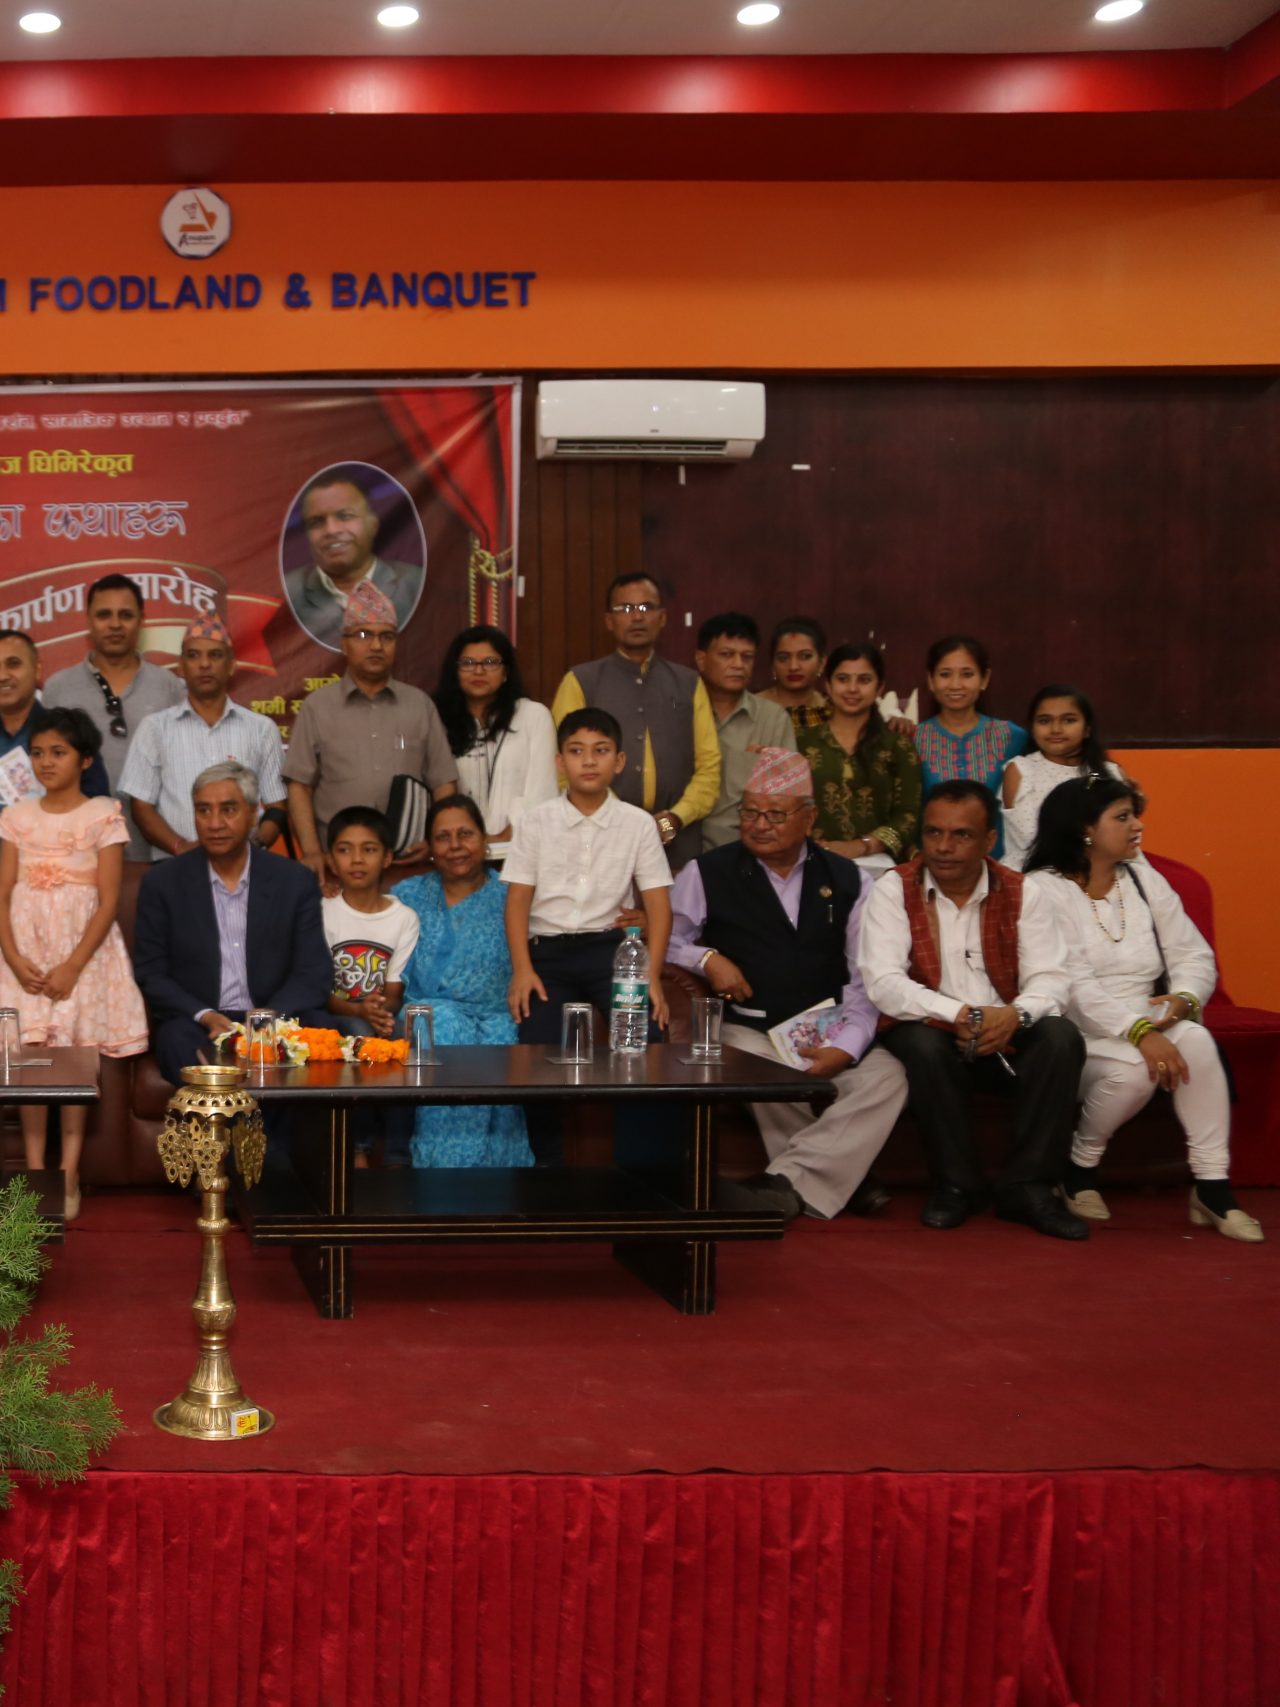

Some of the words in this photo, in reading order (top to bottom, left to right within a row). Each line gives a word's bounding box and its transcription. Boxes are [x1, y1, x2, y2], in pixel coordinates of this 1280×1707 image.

[29, 274, 261, 313] FOODLAND
[284, 273, 312, 309] &
[331, 271, 536, 309] BANQUET
